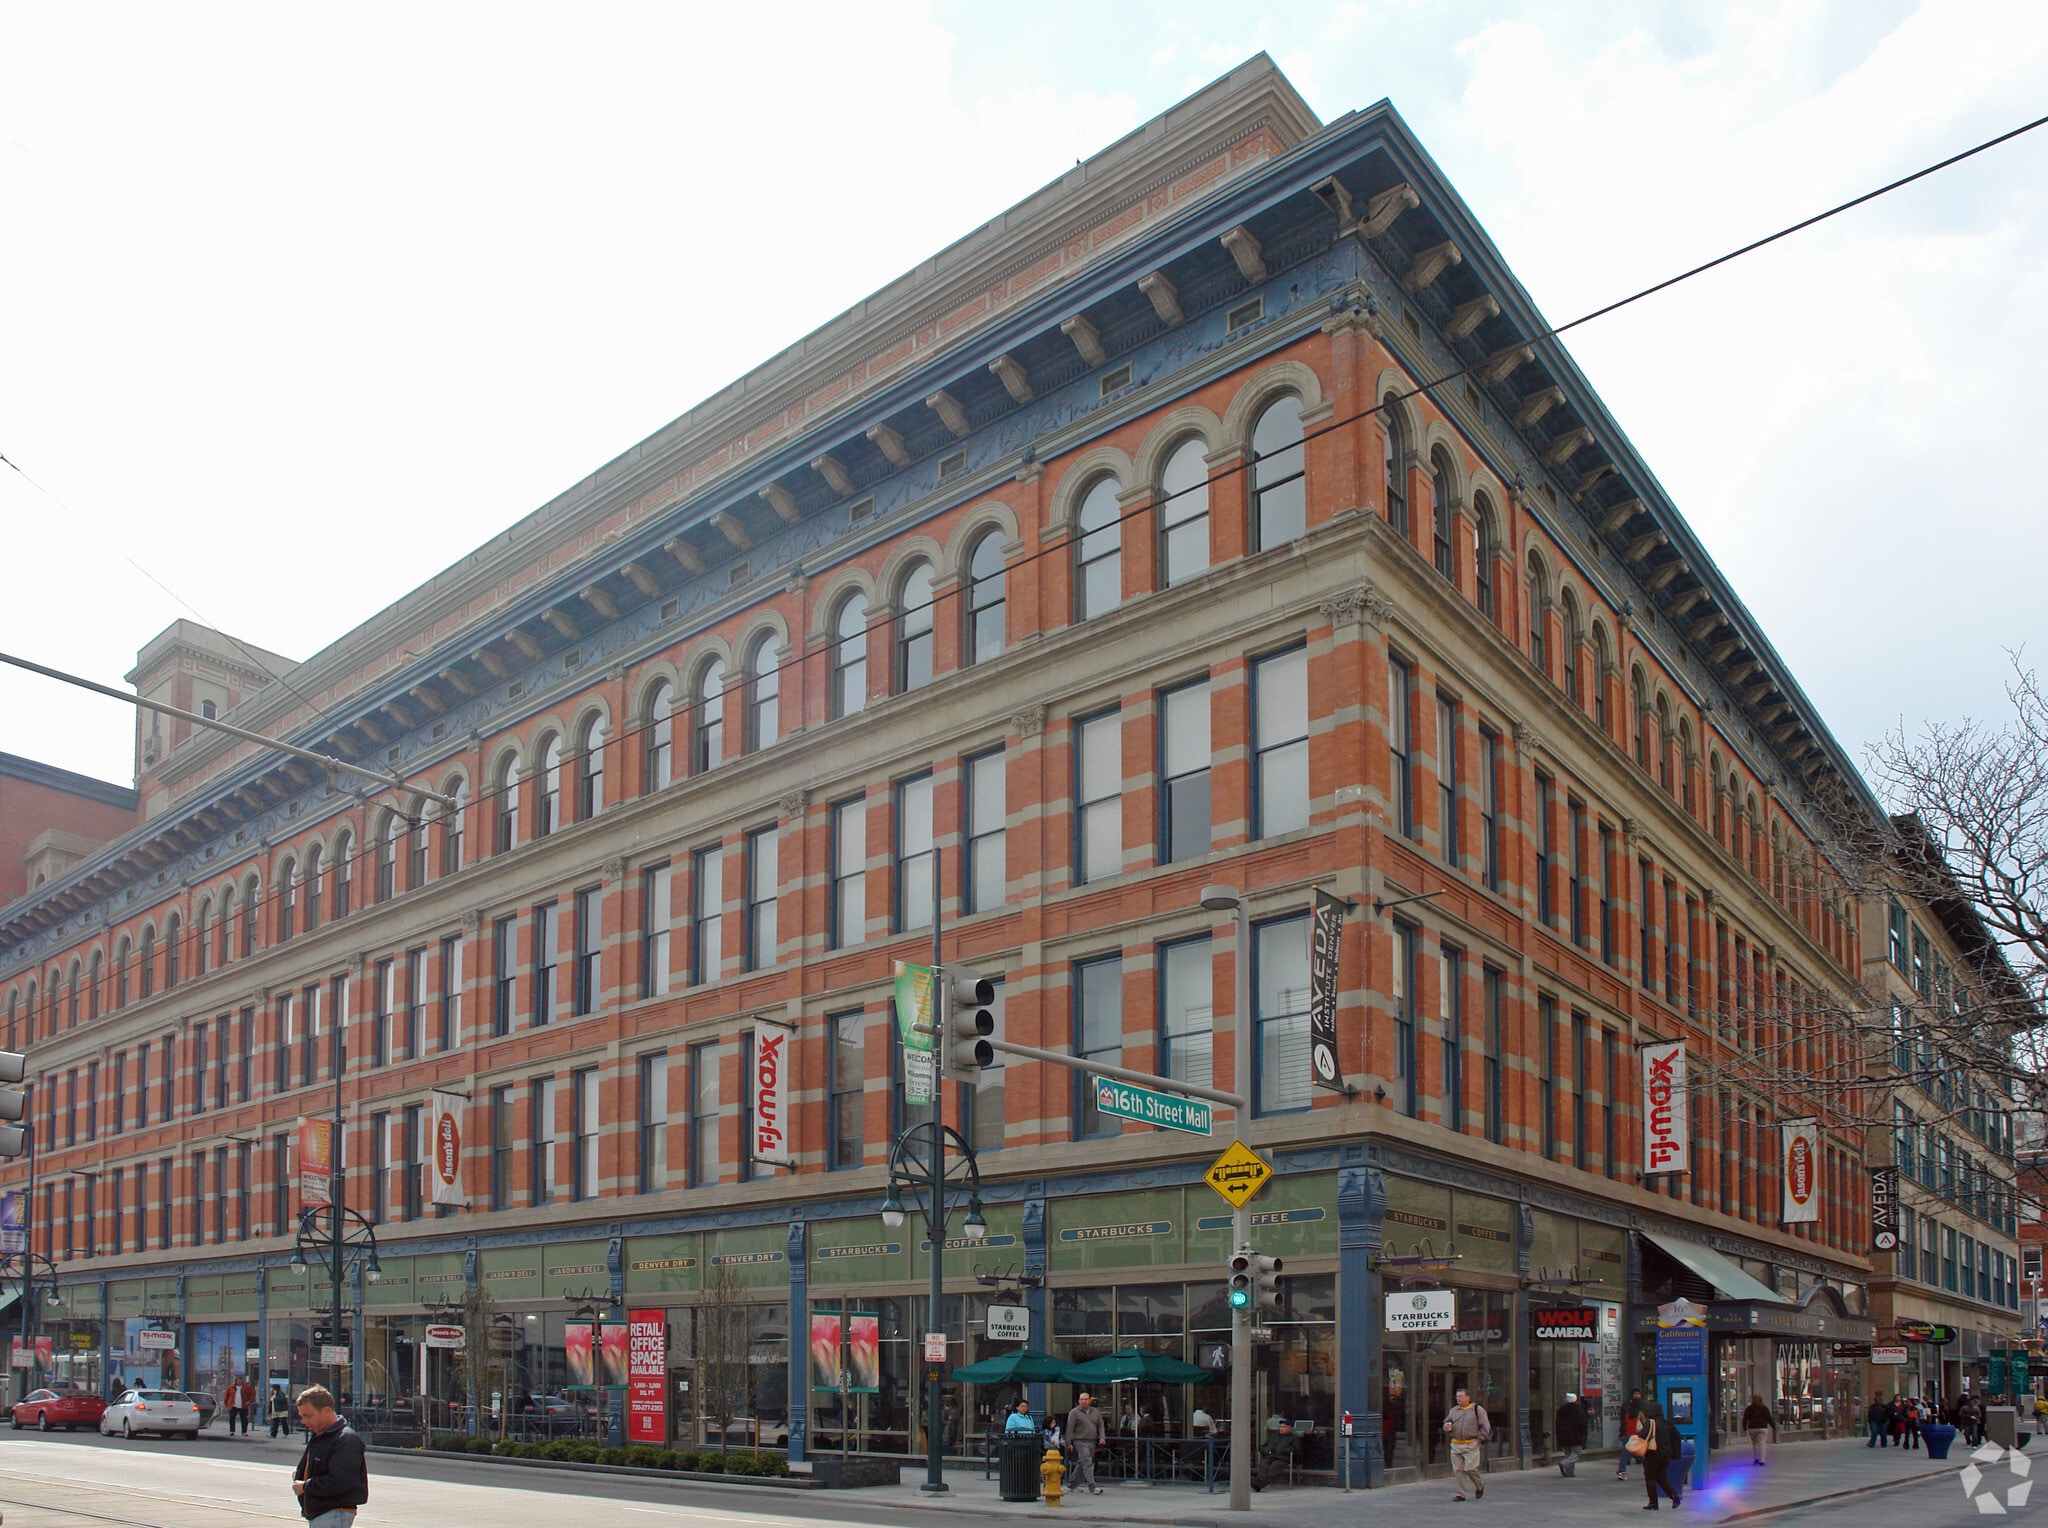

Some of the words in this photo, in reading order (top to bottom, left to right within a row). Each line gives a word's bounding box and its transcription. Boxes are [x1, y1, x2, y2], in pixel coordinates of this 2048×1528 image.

[1327, 914, 1337, 959] DENVER
[1311, 904, 1331, 1032] AVEDA
[915, 971, 932, 1036] DENVE
[1324, 967, 1332, 1028] INSTITUTE
[1113, 1088, 1143, 1115] 16th
[1146, 1096, 1183, 1124] Street
[1186, 1106, 1208, 1129] Mall
[442, 1119, 452, 1140] deli
[443, 1142, 454, 1179] Jason's
[1795, 1164, 1808, 1198] Jason's
[1873, 1170, 1888, 1228] AVEDA
[1394, 1212, 1438, 1229] STARBUCKS
[1076, 1224, 1154, 1239] STARBUCKS
[1472, 1228, 1497, 1240] COFFEE
[945, 1238, 989, 1249] COFFEE
[756, 1253, 775, 1261] DRY
[830, 1245, 888, 1257] STARBUCKS
[553, 1267, 582, 1275] JASON'S
[638, 1261, 669, 1269] DENVER
[672, 1259, 688, 1267] DRY
[490, 1271, 515, 1279] JASON'S
[1391, 1311, 1449, 1321] STARBUCKS
[1537, 1310, 1595, 1326] WOLF
[630, 1322, 664, 1336] RETAIL/
[1402, 1320, 1438, 1328] COFFEE
[1536, 1327, 1593, 1338] CAMERA
[1659, 1330, 1699, 1338] California
[630, 1337, 664, 1351] OFFICE
[631, 1351, 664, 1365] SPACE
[631, 1365, 664, 1374] AVAILABLE
